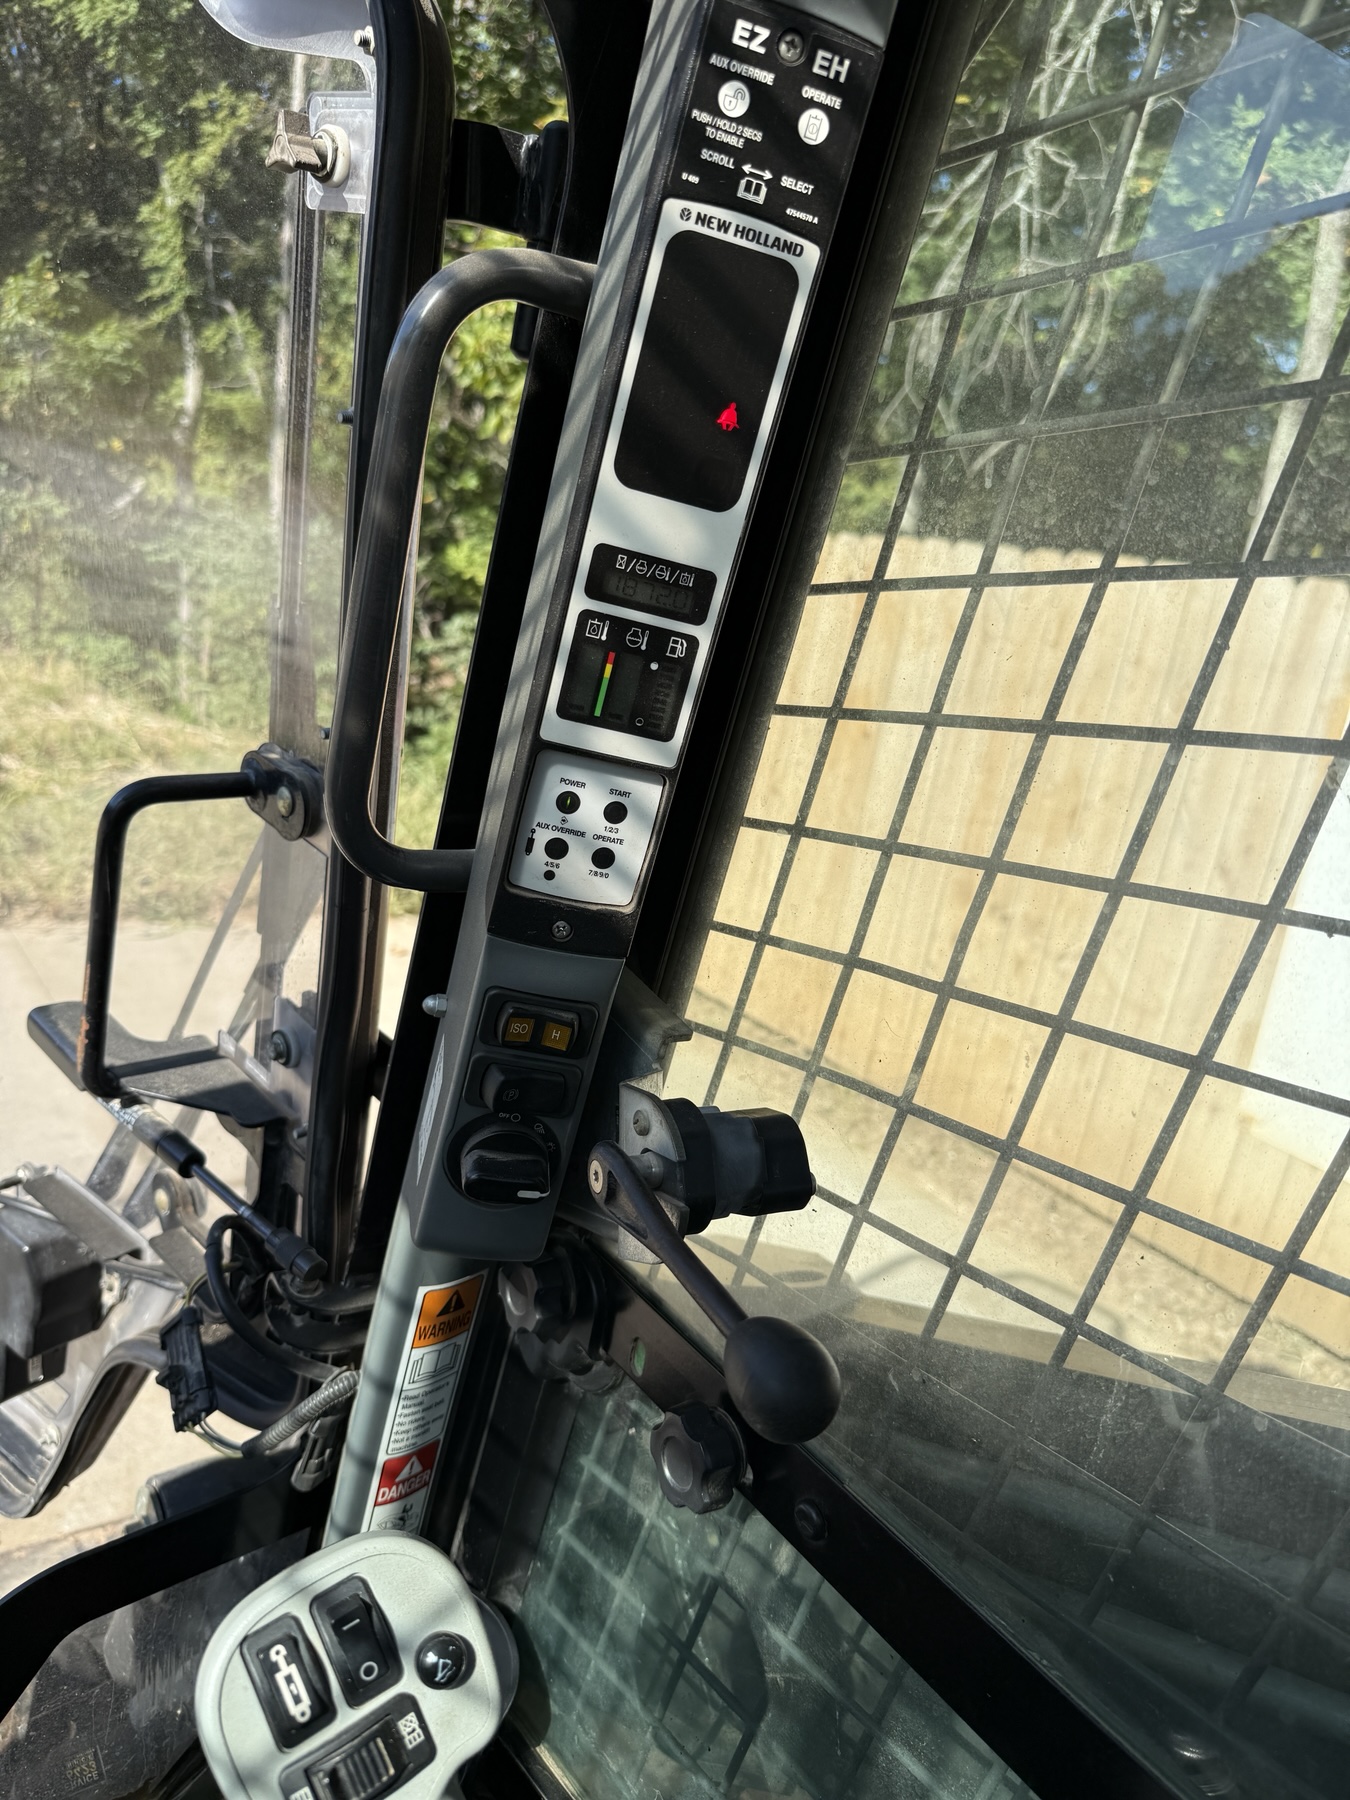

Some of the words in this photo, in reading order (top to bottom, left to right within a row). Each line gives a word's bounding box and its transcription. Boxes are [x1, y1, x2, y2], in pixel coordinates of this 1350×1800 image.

[731, 18, 771, 54] EZ
[709, 53, 730, 69] AUX
[729, 61, 775, 86] OVERRIDE
[812, 49, 851, 83] EH
[801, 85, 843, 110] OPERATE
[691, 109, 713, 125] PUSH
[716, 118, 738, 133] HOLD
[737, 126, 743, 136] 2
[742, 128, 763, 142] SECS
[705, 127, 716, 139] TO
[716, 130, 745, 149] ENABLE
[700, 149, 735, 170] SCROLL
[780, 175, 814, 196] SELECT
[694, 211, 732, 235] NEW
[733, 224, 805, 258] HOLLAND
[559, 777, 586, 789] POWER
[609, 788, 632, 799] START
[535, 821, 550, 830] AUX
[551, 825, 586, 839] OVERRIDE
[592, 834, 624, 846] OPERATE
[603, 826, 619, 834] 1/2/3
[509, 1023, 528, 1034] ISO
[551, 1030, 560, 1040] H
[417, 1312, 472, 1341] WARNING
[377, 1469, 431, 1501] DANGER
